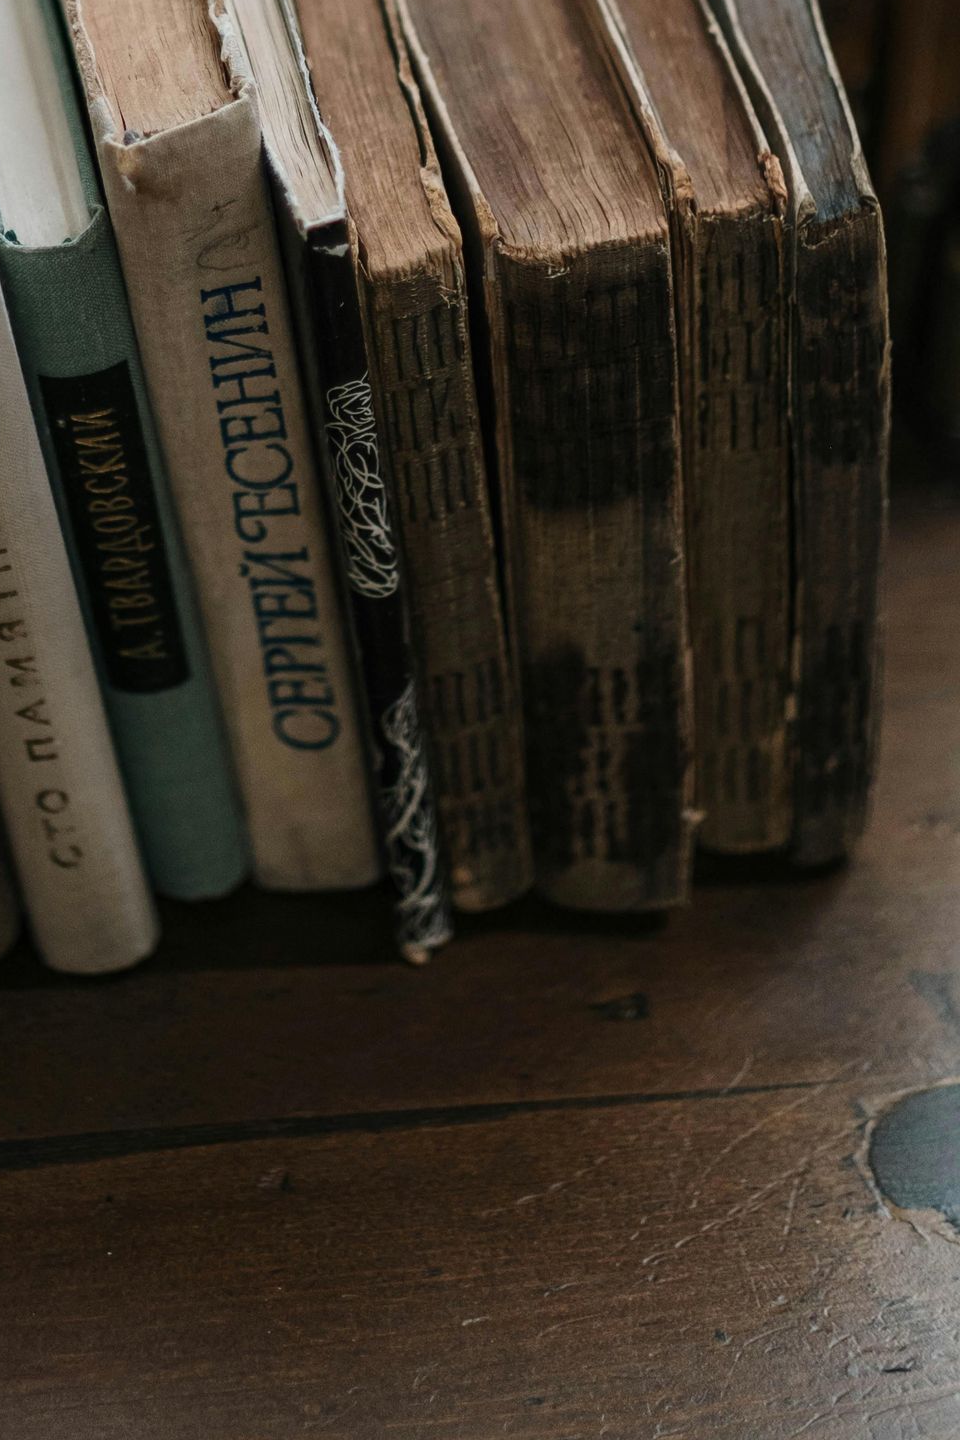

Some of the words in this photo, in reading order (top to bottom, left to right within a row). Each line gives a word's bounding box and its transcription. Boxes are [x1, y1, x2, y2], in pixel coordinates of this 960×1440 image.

[200, 276, 301, 543] ЕСЕНИН
[239, 546, 341, 751] СЕРГЕЙ
[36, 787, 84, 869] СТО
